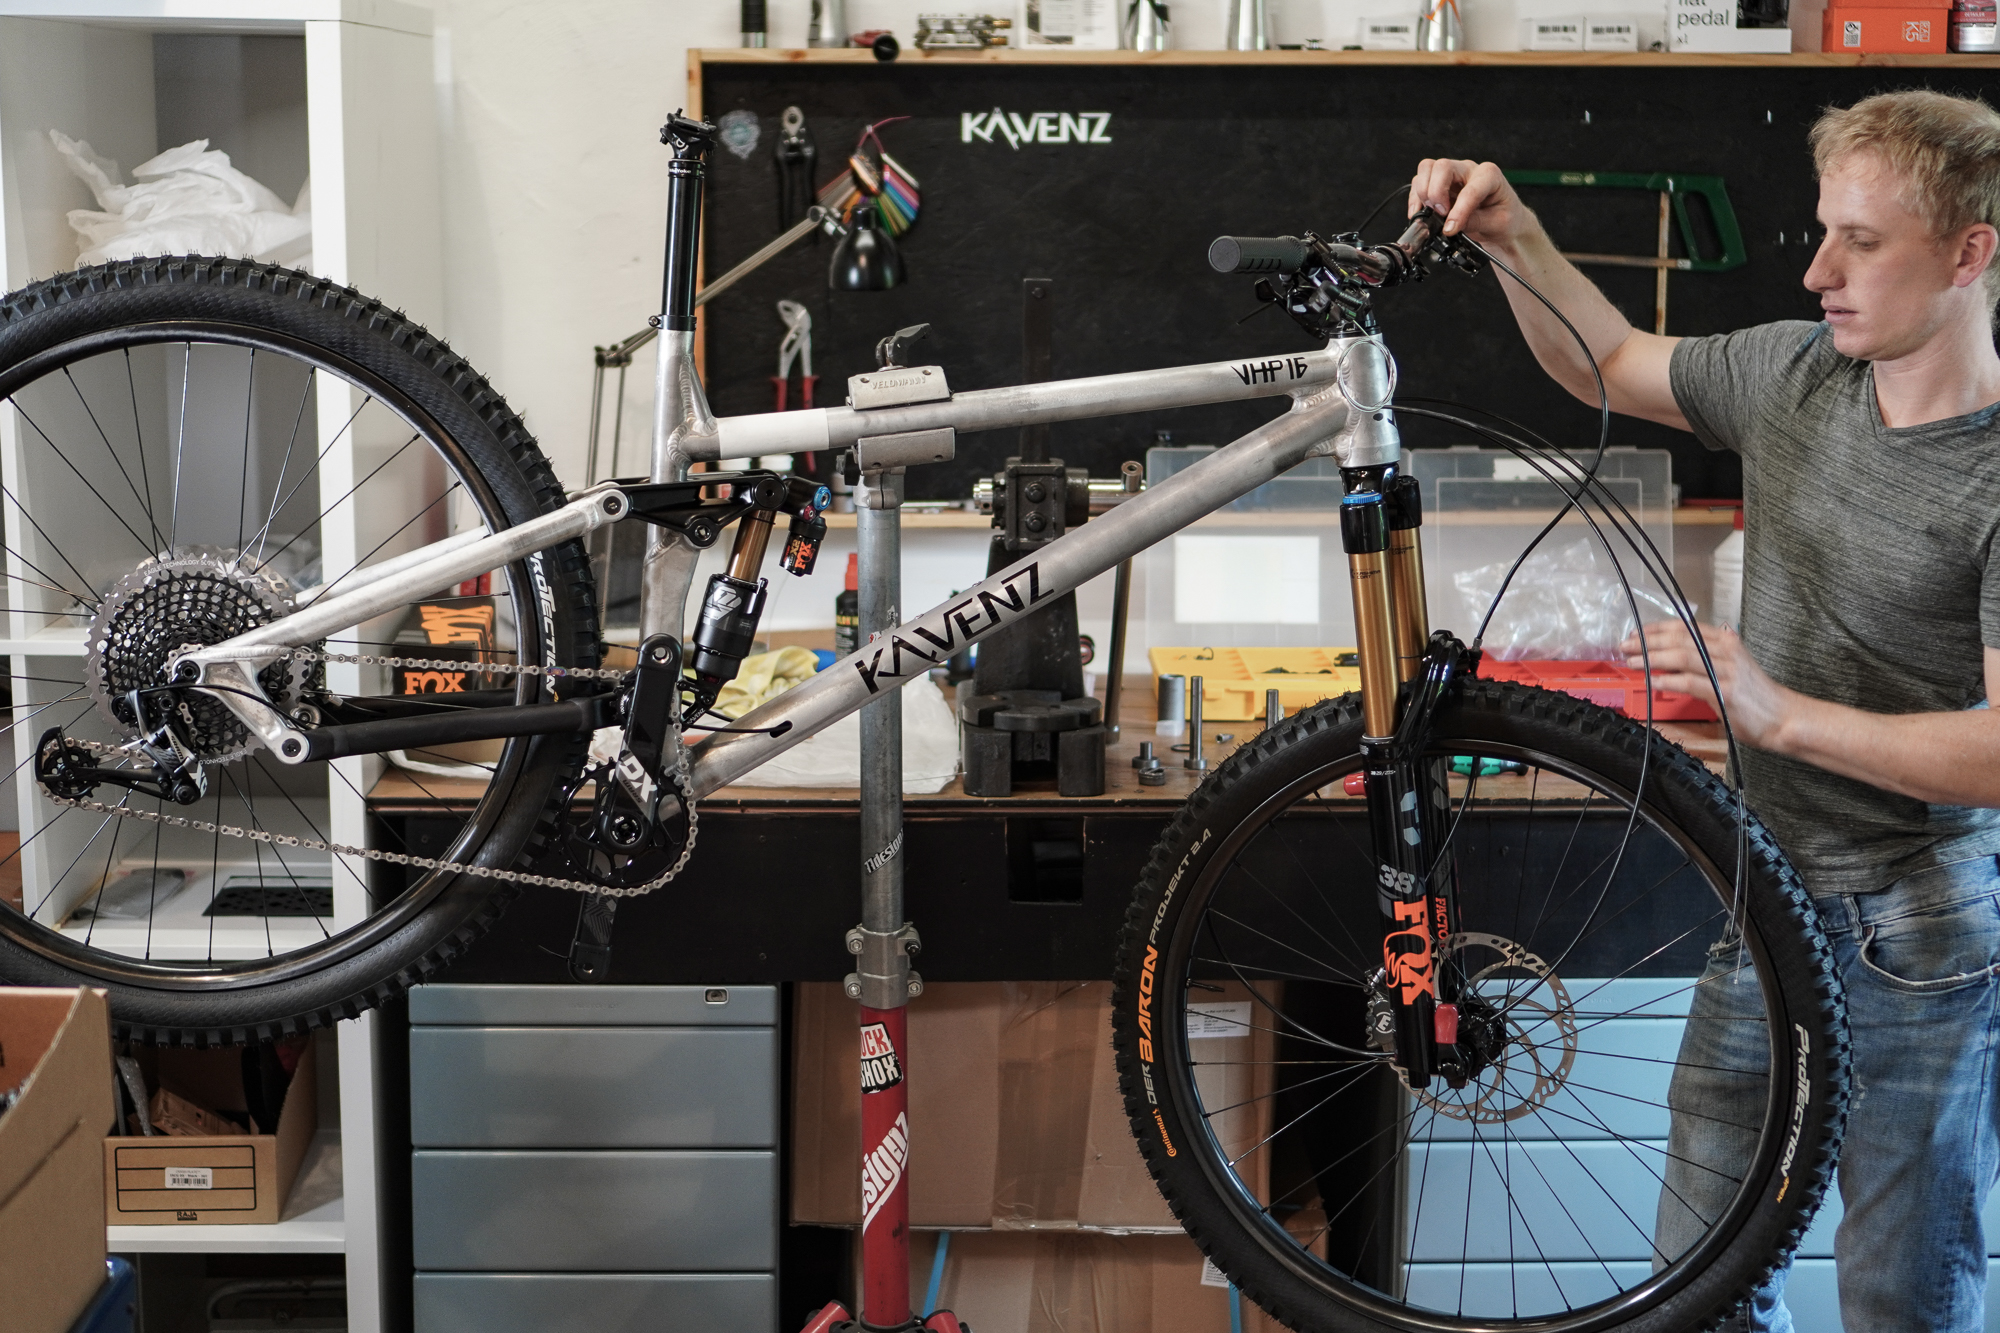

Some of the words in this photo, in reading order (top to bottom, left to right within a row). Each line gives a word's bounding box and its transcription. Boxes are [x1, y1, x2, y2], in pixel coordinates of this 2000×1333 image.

[1677, 8, 1729, 29] pedal
[1905, 21, 1920, 42] K5
[1677, 33, 1688, 44] xl
[961, 106, 1112, 150] KAVENZ
[143, 564, 162, 577] EAGLE
[162, 559, 200, 569] TECHNOLOGY
[795, 541, 813, 570] FOX
[855, 562, 1054, 694] KAVENZ
[404, 671, 466, 695] FOX
[1190, 828, 1211, 855] 2.4
[1379, 864, 1415, 894] 38
[1149, 854, 1189, 944] PROJEKT
[1435, 897, 1449, 940] FACTO
[1384, 895, 1434, 1005] FOX
[1138, 944, 1158, 1063] BARON
[861, 1028, 889, 1057] OCK
[1142, 1063, 1157, 1105] DER
[1154, 1114, 1177, 1157] Continental
